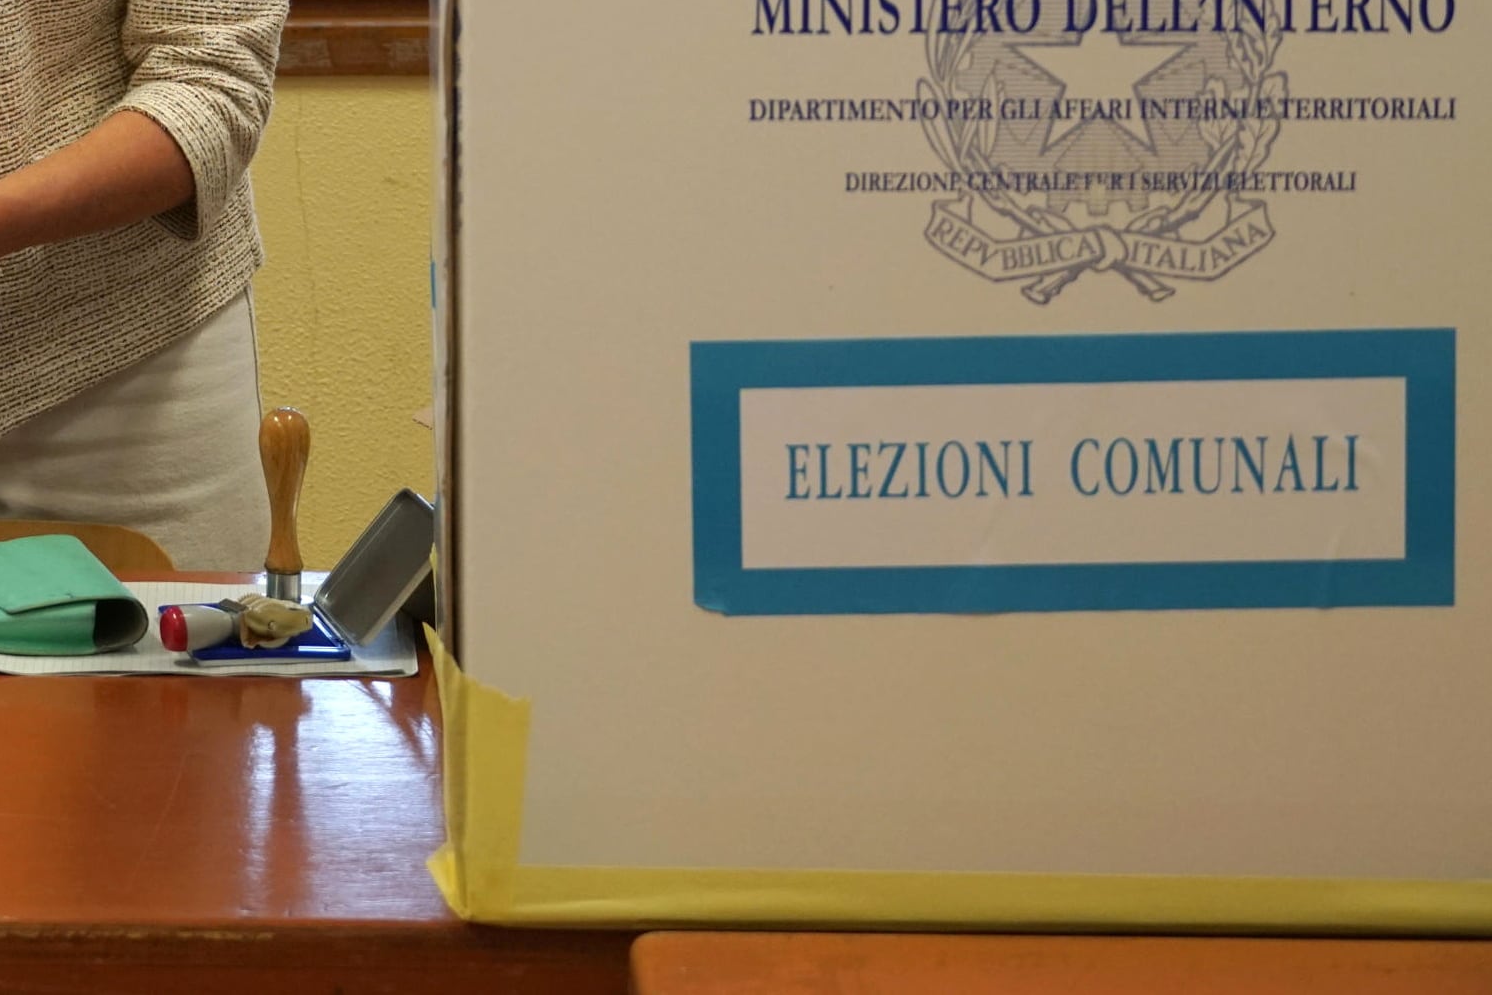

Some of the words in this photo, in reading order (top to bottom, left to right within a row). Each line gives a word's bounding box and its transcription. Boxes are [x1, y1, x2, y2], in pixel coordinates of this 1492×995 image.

[748, 98, 940, 121] DIPARTIMENTO
[947, 98, 994, 121] PER
[1000, 98, 1041, 121] GLI
[1050, 98, 1132, 120] AFFARI
[1140, 97, 1250, 120] INTERNI
[1277, 97, 1456, 120] TERRITORIALI
[845, 172, 962, 192] DIREZIONE
[966, 172, 1077, 192] CENTRALE
[1142, 171, 1221, 191] SERVIZI
[1227, 171, 1357, 191] ELETTORALI
[1128, 221, 1268, 272] ITALIANA
[785, 439, 1035, 500] ELEZIONI
[1070, 433, 1361, 497] COMUNALI
